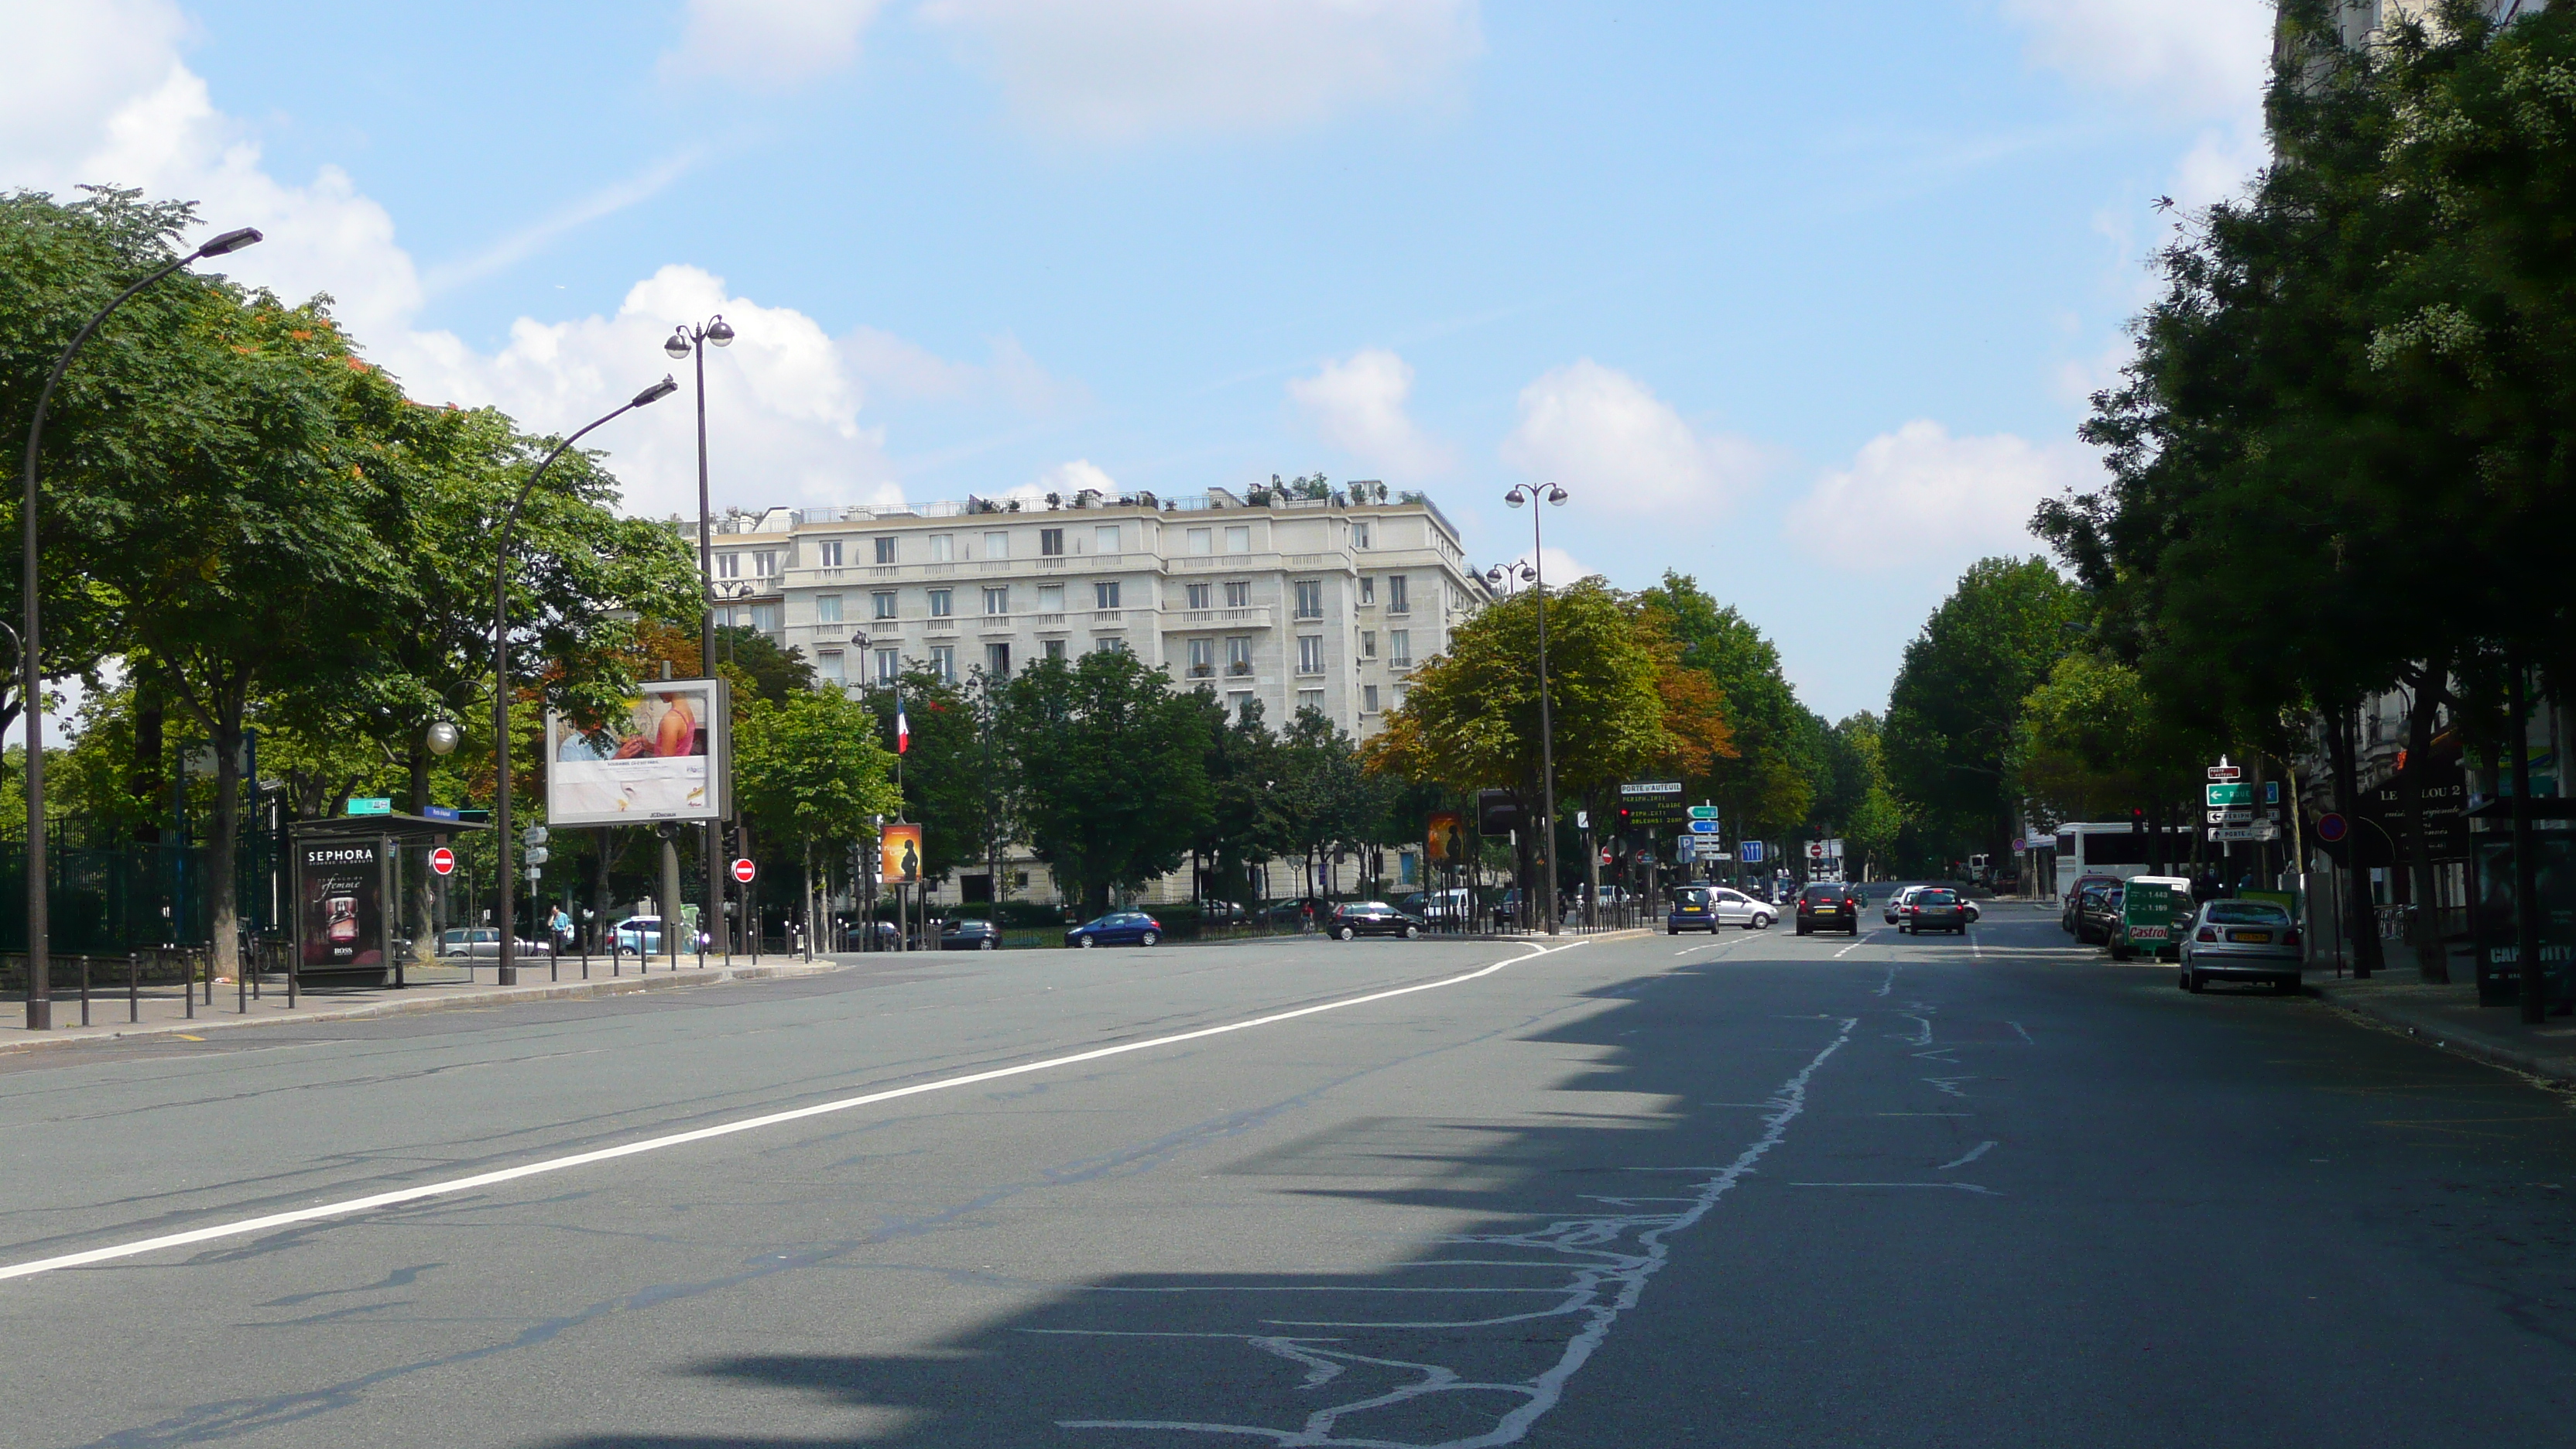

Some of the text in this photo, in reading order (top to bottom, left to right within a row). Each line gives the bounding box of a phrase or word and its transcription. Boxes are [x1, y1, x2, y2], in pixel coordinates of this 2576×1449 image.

[2380, 790, 2398, 800] LE
[2451, 785, 2461, 796] 2
[308, 849, 373, 862] SEPHORA
[2130, 927, 2168, 937] Castrol
[2489, 946, 2571, 963] CAPVITY
